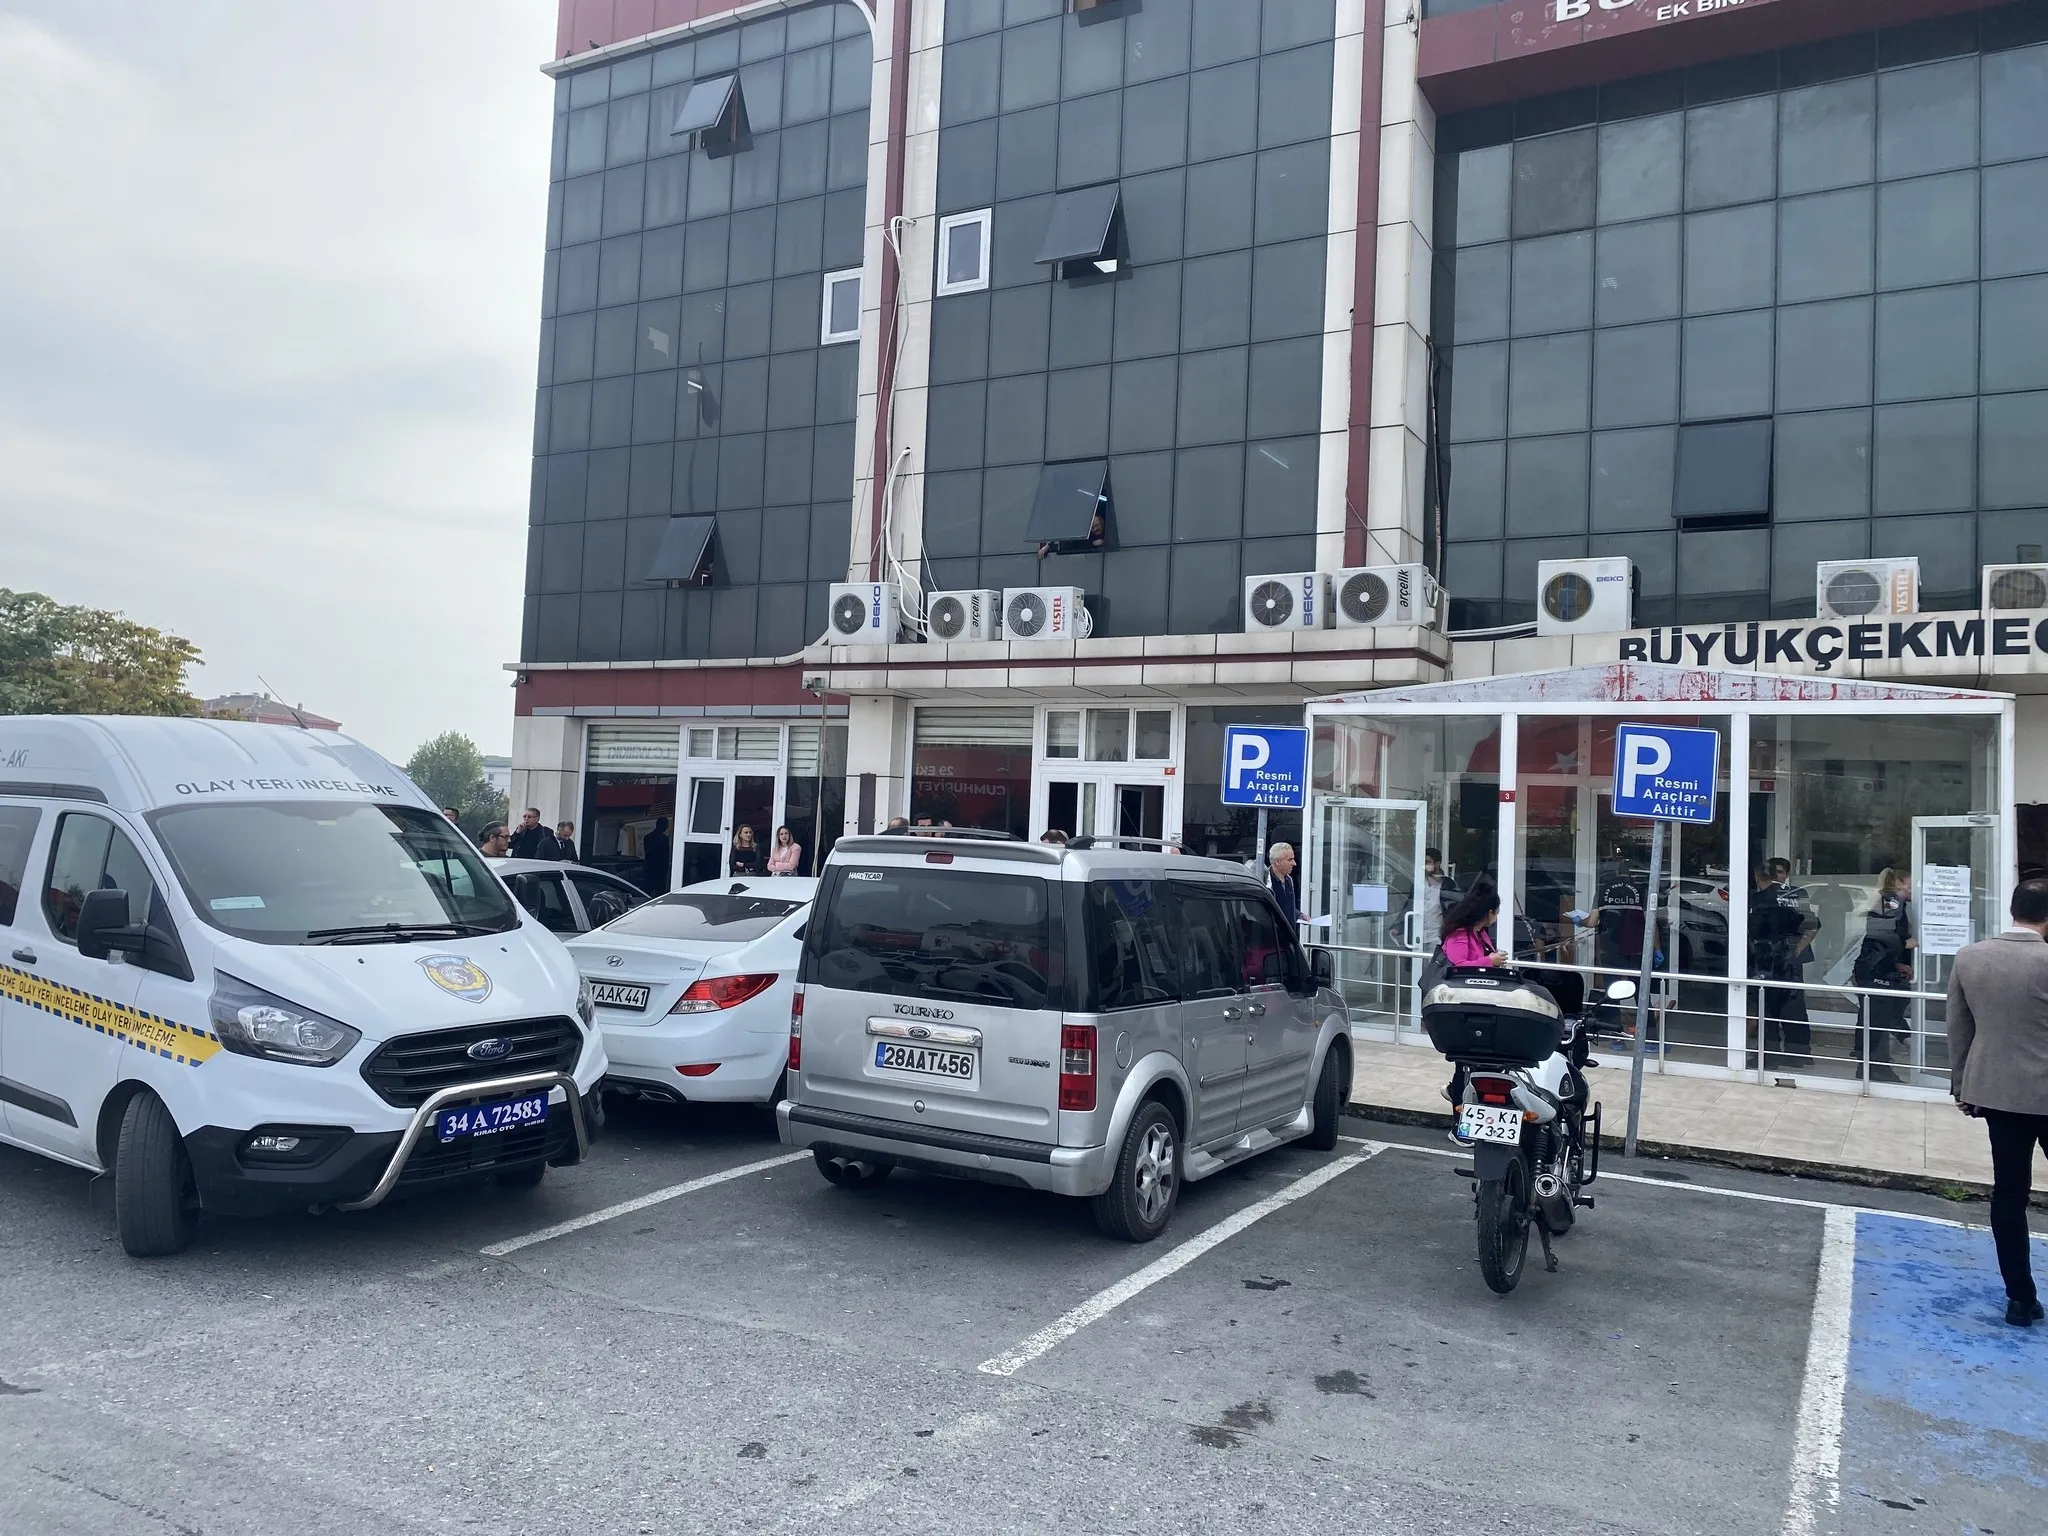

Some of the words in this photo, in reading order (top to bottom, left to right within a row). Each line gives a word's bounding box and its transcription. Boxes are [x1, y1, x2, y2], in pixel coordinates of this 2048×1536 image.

[1657, 3, 1690, 21] EK
[1596, 575, 1624, 583] BEKO
[1398, 569, 1411, 608] arçelik
[872, 585, 881, 628] BEKO
[1303, 576, 1313, 626] BEKO
[971, 594, 980, 628] arçelik
[1053, 595, 1062, 632] VESTEL
[1229, 734, 1270, 789] P
[1621, 734, 1672, 798] P
[1256, 770, 1292, 781] Resmi
[1654, 776, 1699, 791] Resmi
[175, 779, 236, 795] OLAY
[1246, 781, 1299, 793] Araçlara
[1254, 793, 1290, 804] Aittir
[1652, 803, 1696, 817] Aittir
[1608, 896, 1635, 904] POLİS
[0, 974, 16, 990] LEME
[19, 980, 36, 996] OLAY
[92, 1006, 113, 1023] OLAY
[893, 1003, 954, 1020] TOURNEO
[480, 1042, 505, 1056] Ford
[884, 1046, 971, 1076] 28AAT456
[446, 1113, 469, 1135] 34
[472, 1110, 488, 1130] A
[492, 1099, 542, 1126] 72583
[1465, 1107, 1486, 1120] 45
[1499, 1112, 1518, 1125] KA
[499, 1124, 515, 1132] OTO
[1474, 1123, 1517, 1140] 7323
